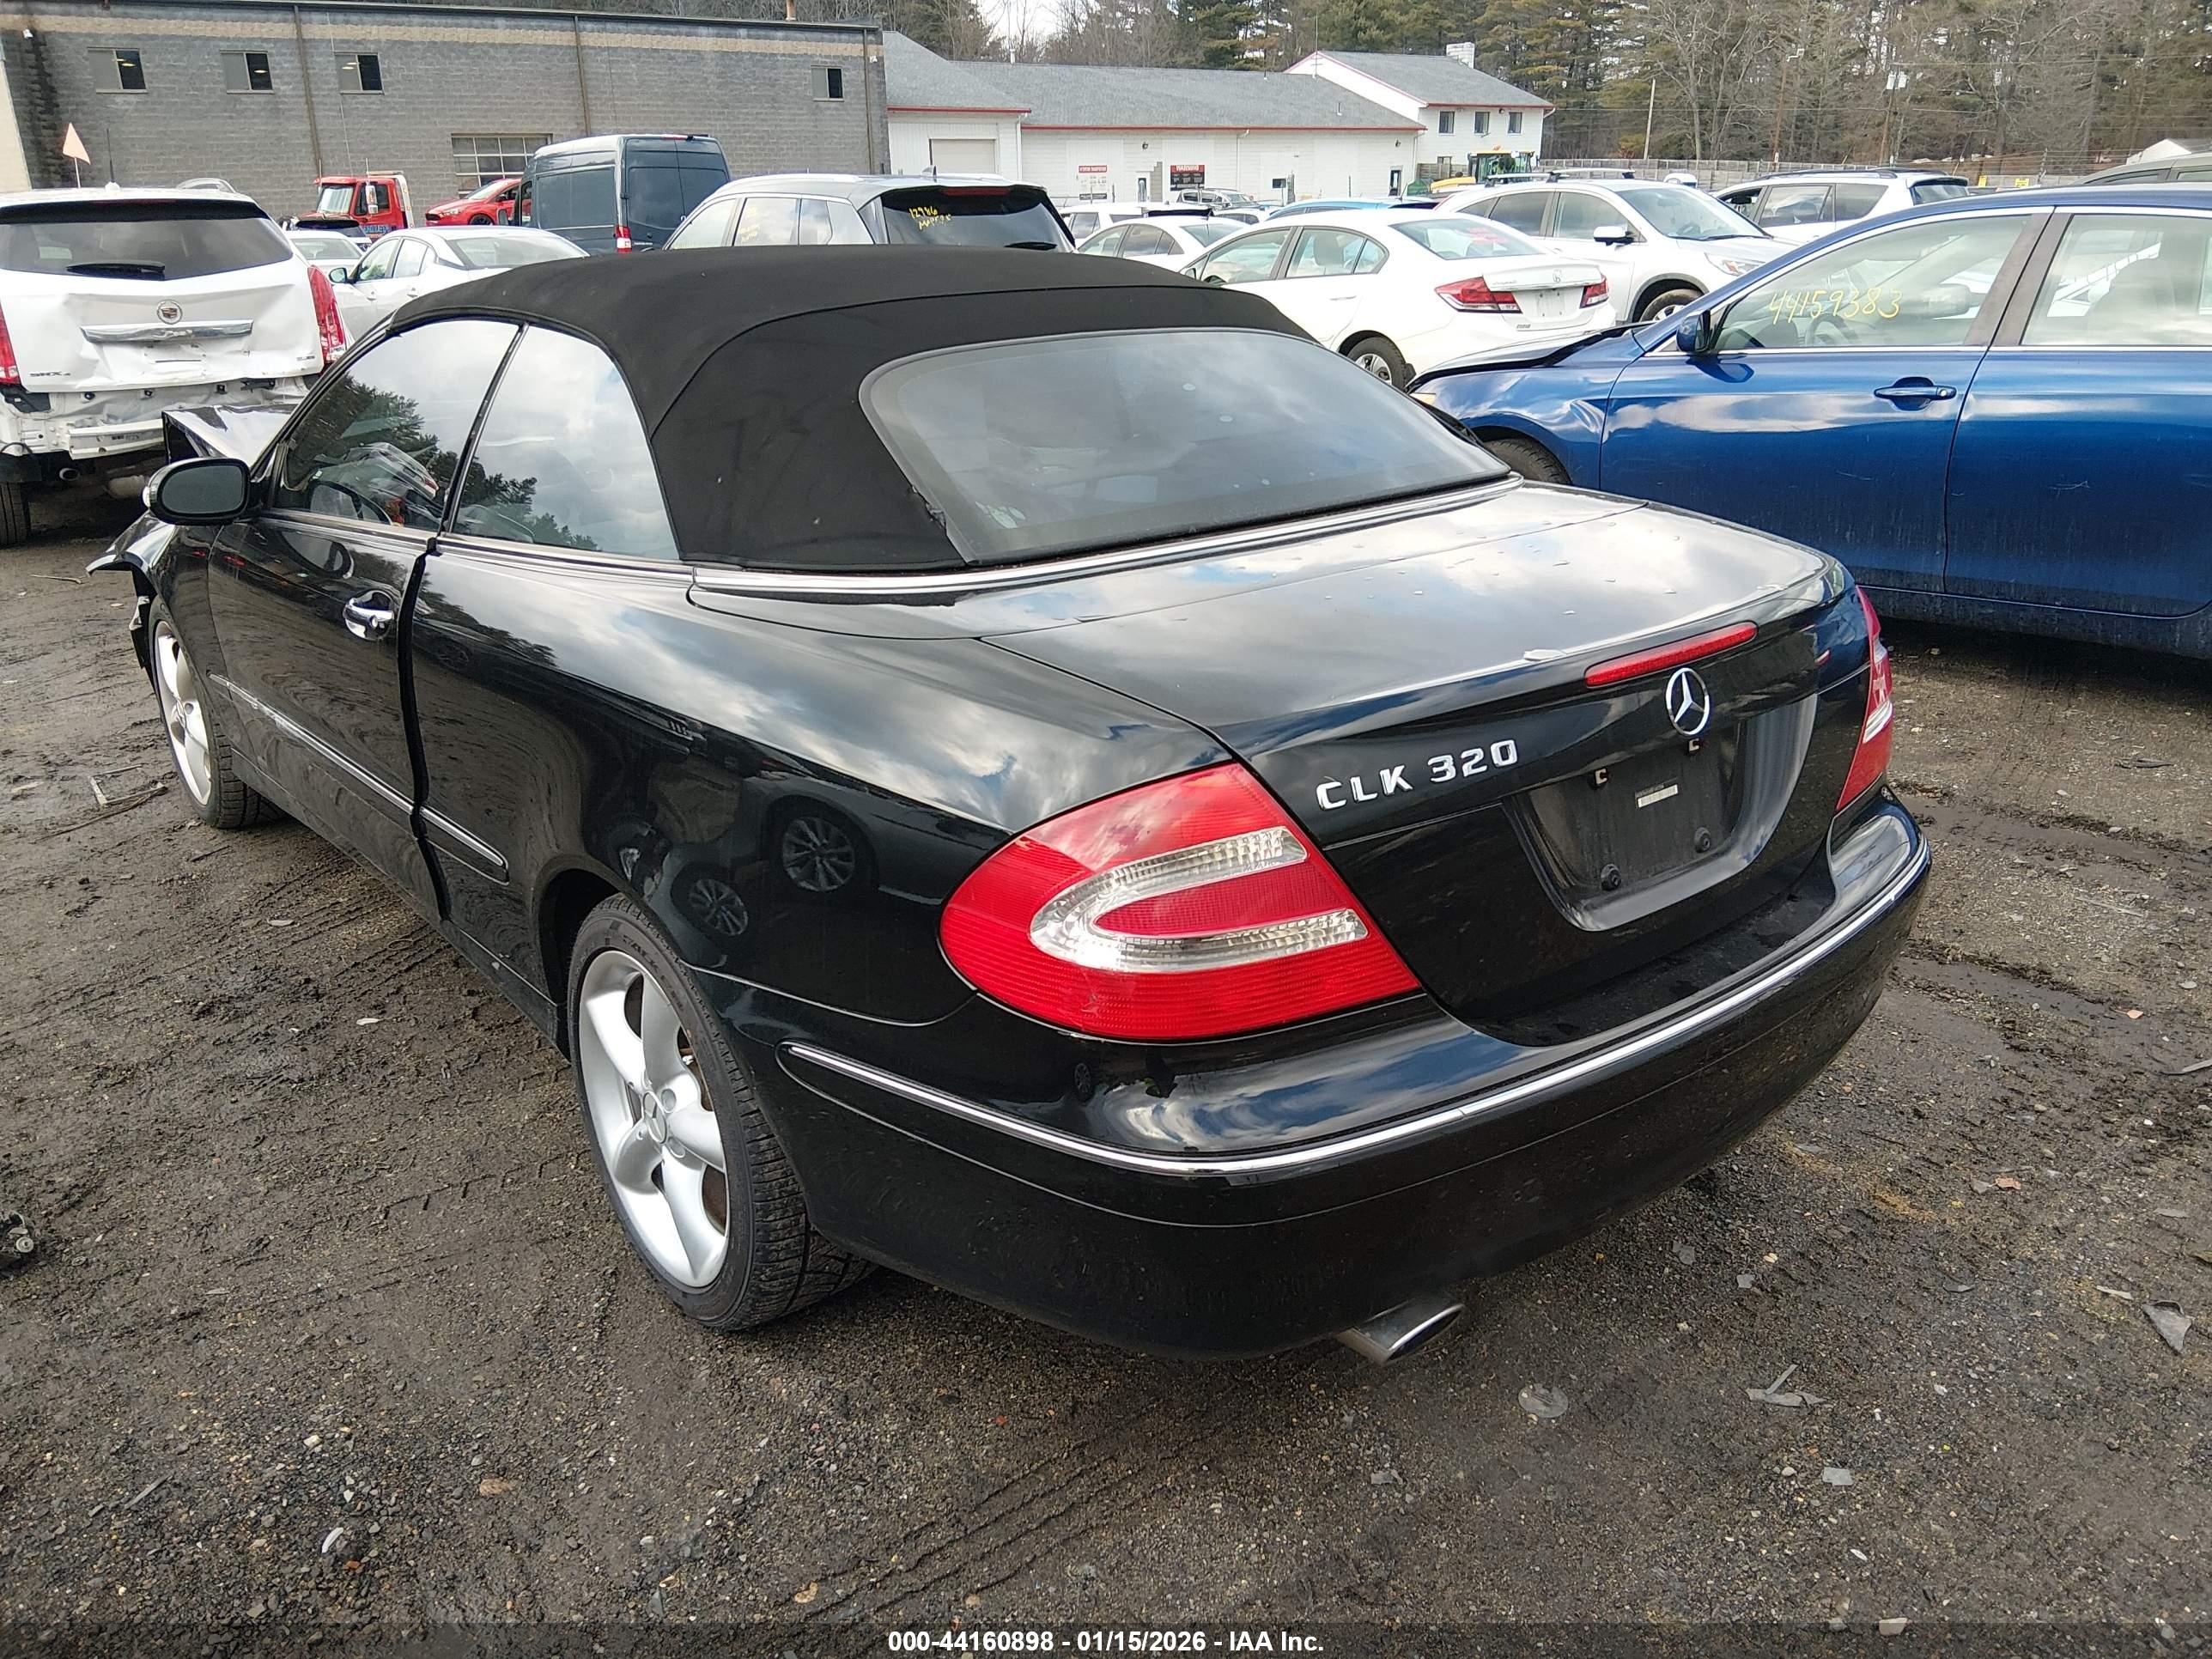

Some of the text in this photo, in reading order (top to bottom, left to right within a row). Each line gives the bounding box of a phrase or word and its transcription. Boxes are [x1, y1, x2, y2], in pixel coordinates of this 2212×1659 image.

[1769, 288, 1904, 325] 44159383
[1316, 739, 1518, 810] CLK 320
